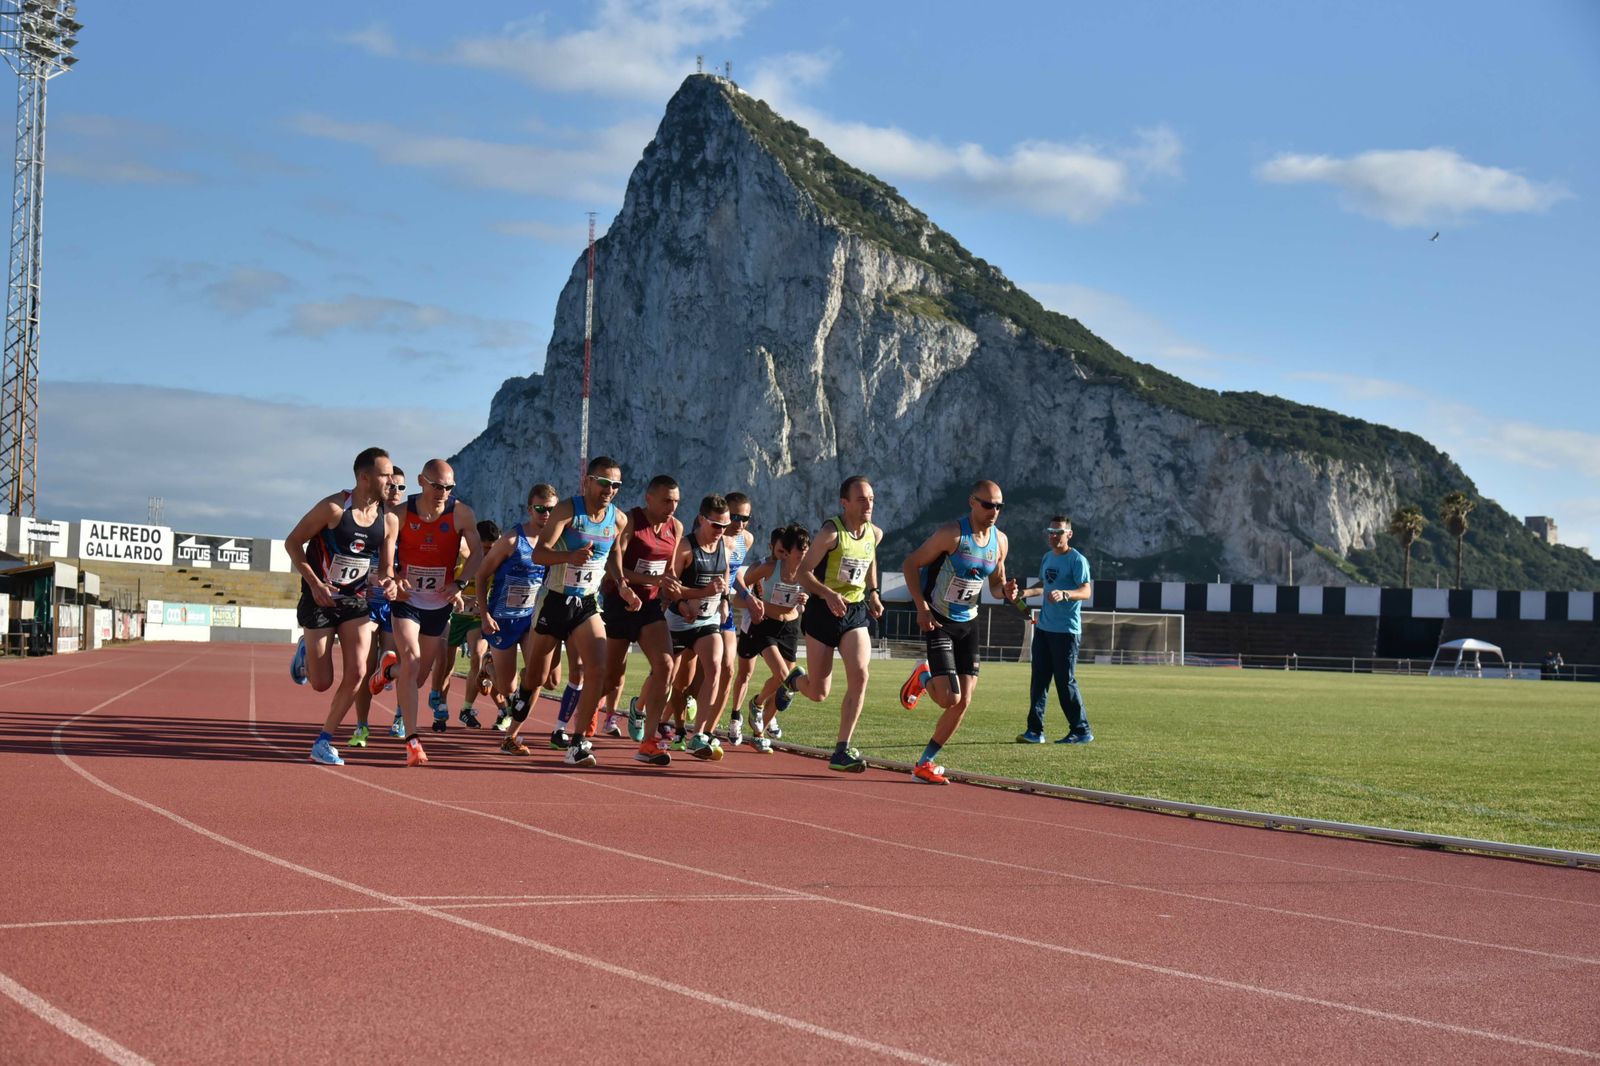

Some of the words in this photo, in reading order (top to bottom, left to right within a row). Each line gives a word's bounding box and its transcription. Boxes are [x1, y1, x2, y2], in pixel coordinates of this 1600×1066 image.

[90, 524, 161, 544] ALFREDO
[86, 542, 163, 561] GALLARDO
[178, 547, 211, 561] LOTUS
[217, 549, 250, 563] LOTUS
[341, 566, 360, 580] 10
[575, 570, 593, 583] 14
[848, 567, 862, 579] 19
[416, 576, 437, 589] 12
[521, 594, 530, 604] 7
[784, 593, 791, 603] 1
[957, 588, 974, 601] 15
[700, 602, 709, 612] 4
